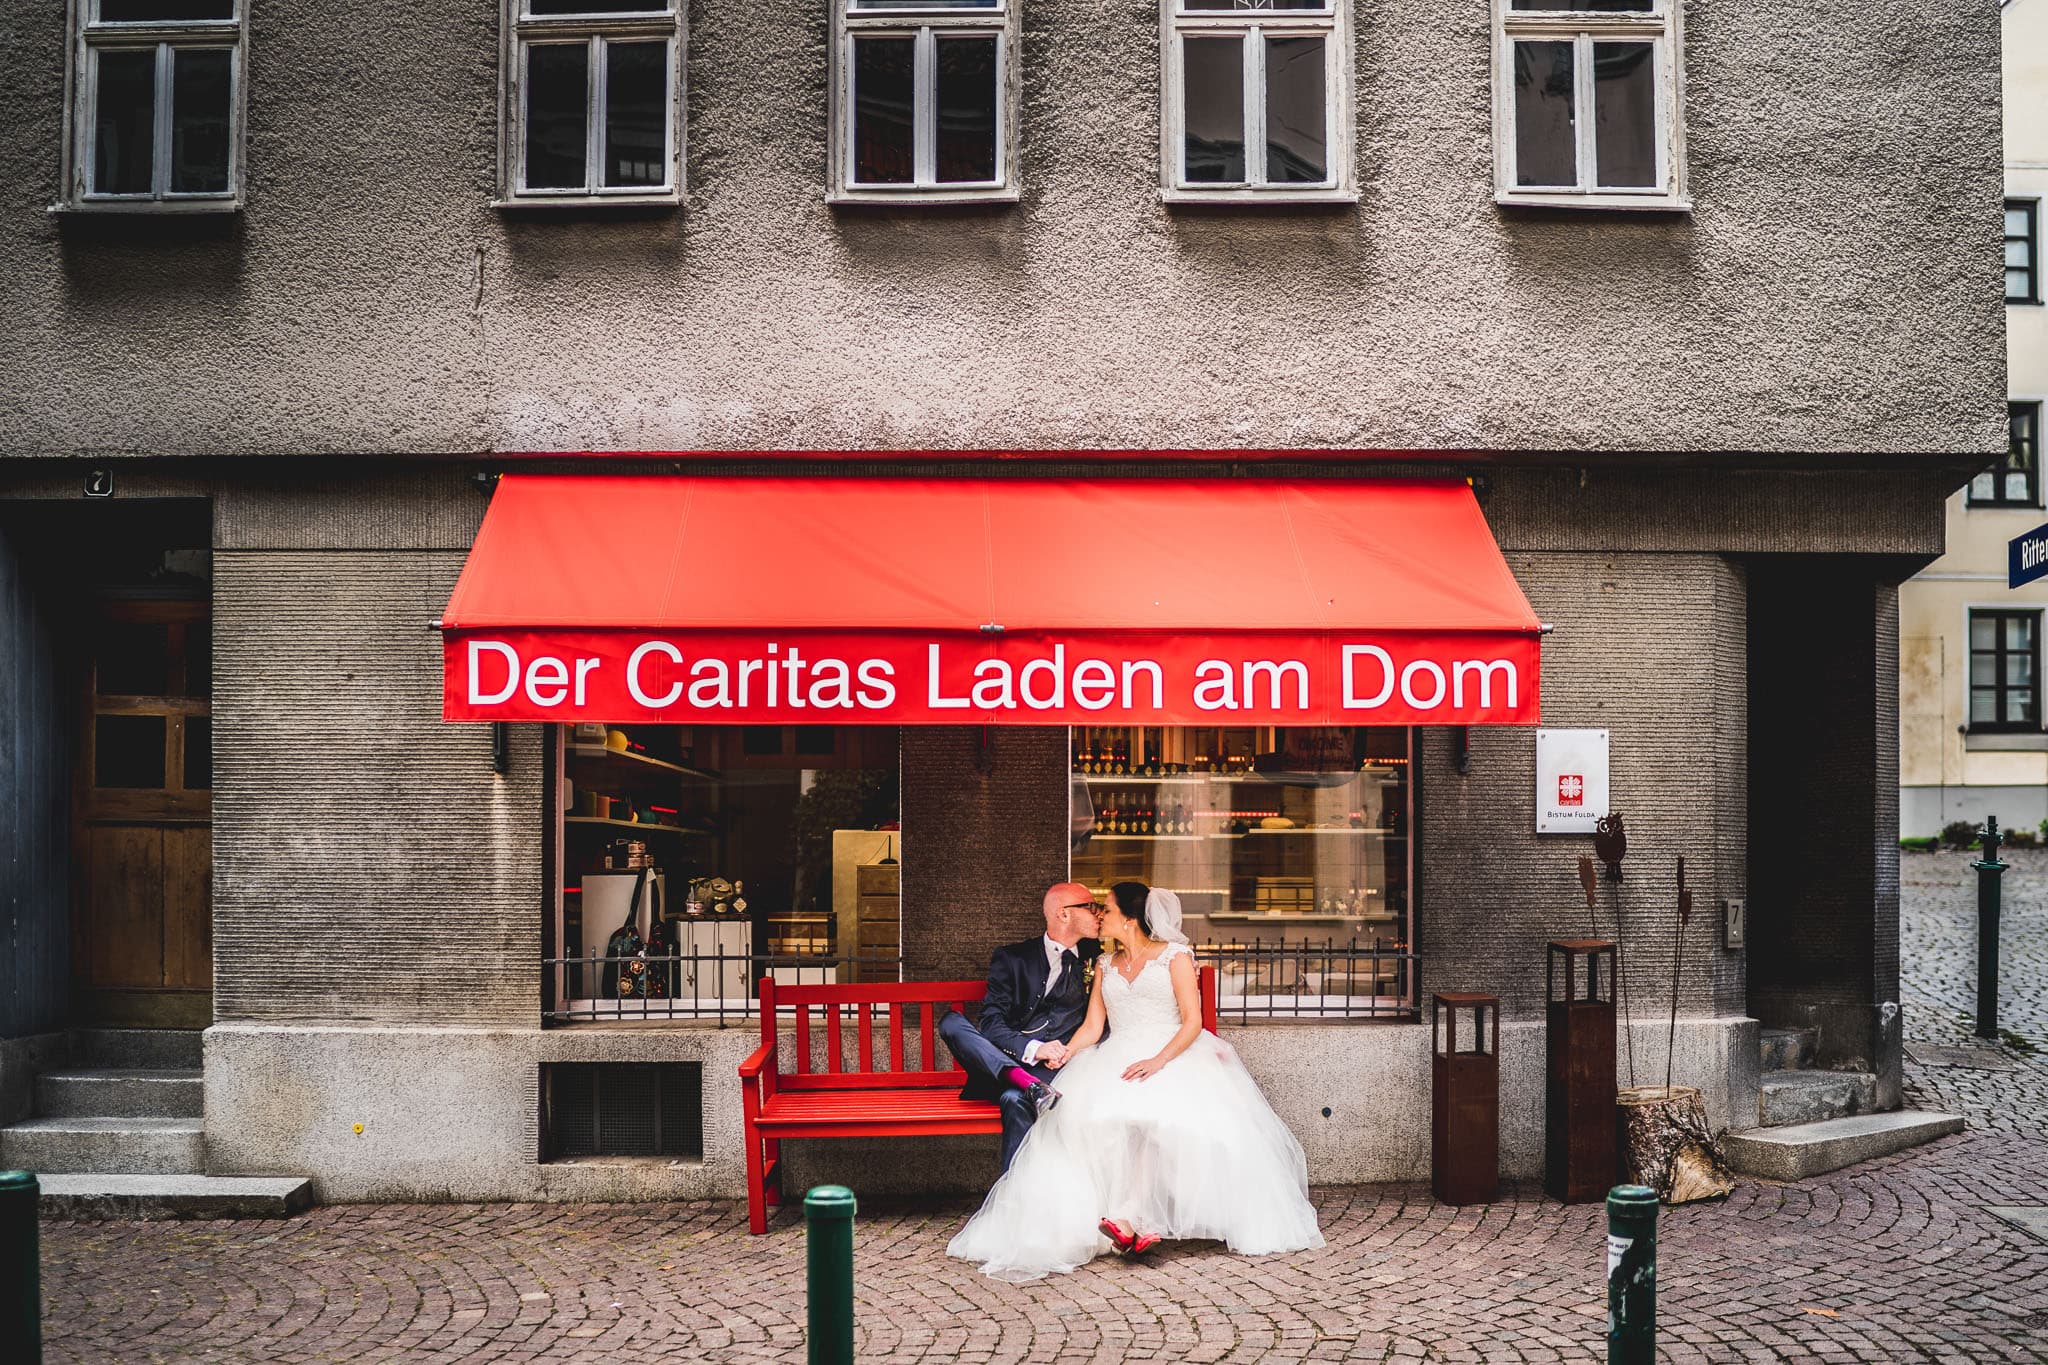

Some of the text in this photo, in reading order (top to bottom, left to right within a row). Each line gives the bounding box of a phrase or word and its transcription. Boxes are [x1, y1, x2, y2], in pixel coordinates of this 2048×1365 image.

[92, 470, 104, 491] 7
[467, 640, 1518, 710] Der Caritas Laden am Dom
[1731, 904, 1739, 925] 7
